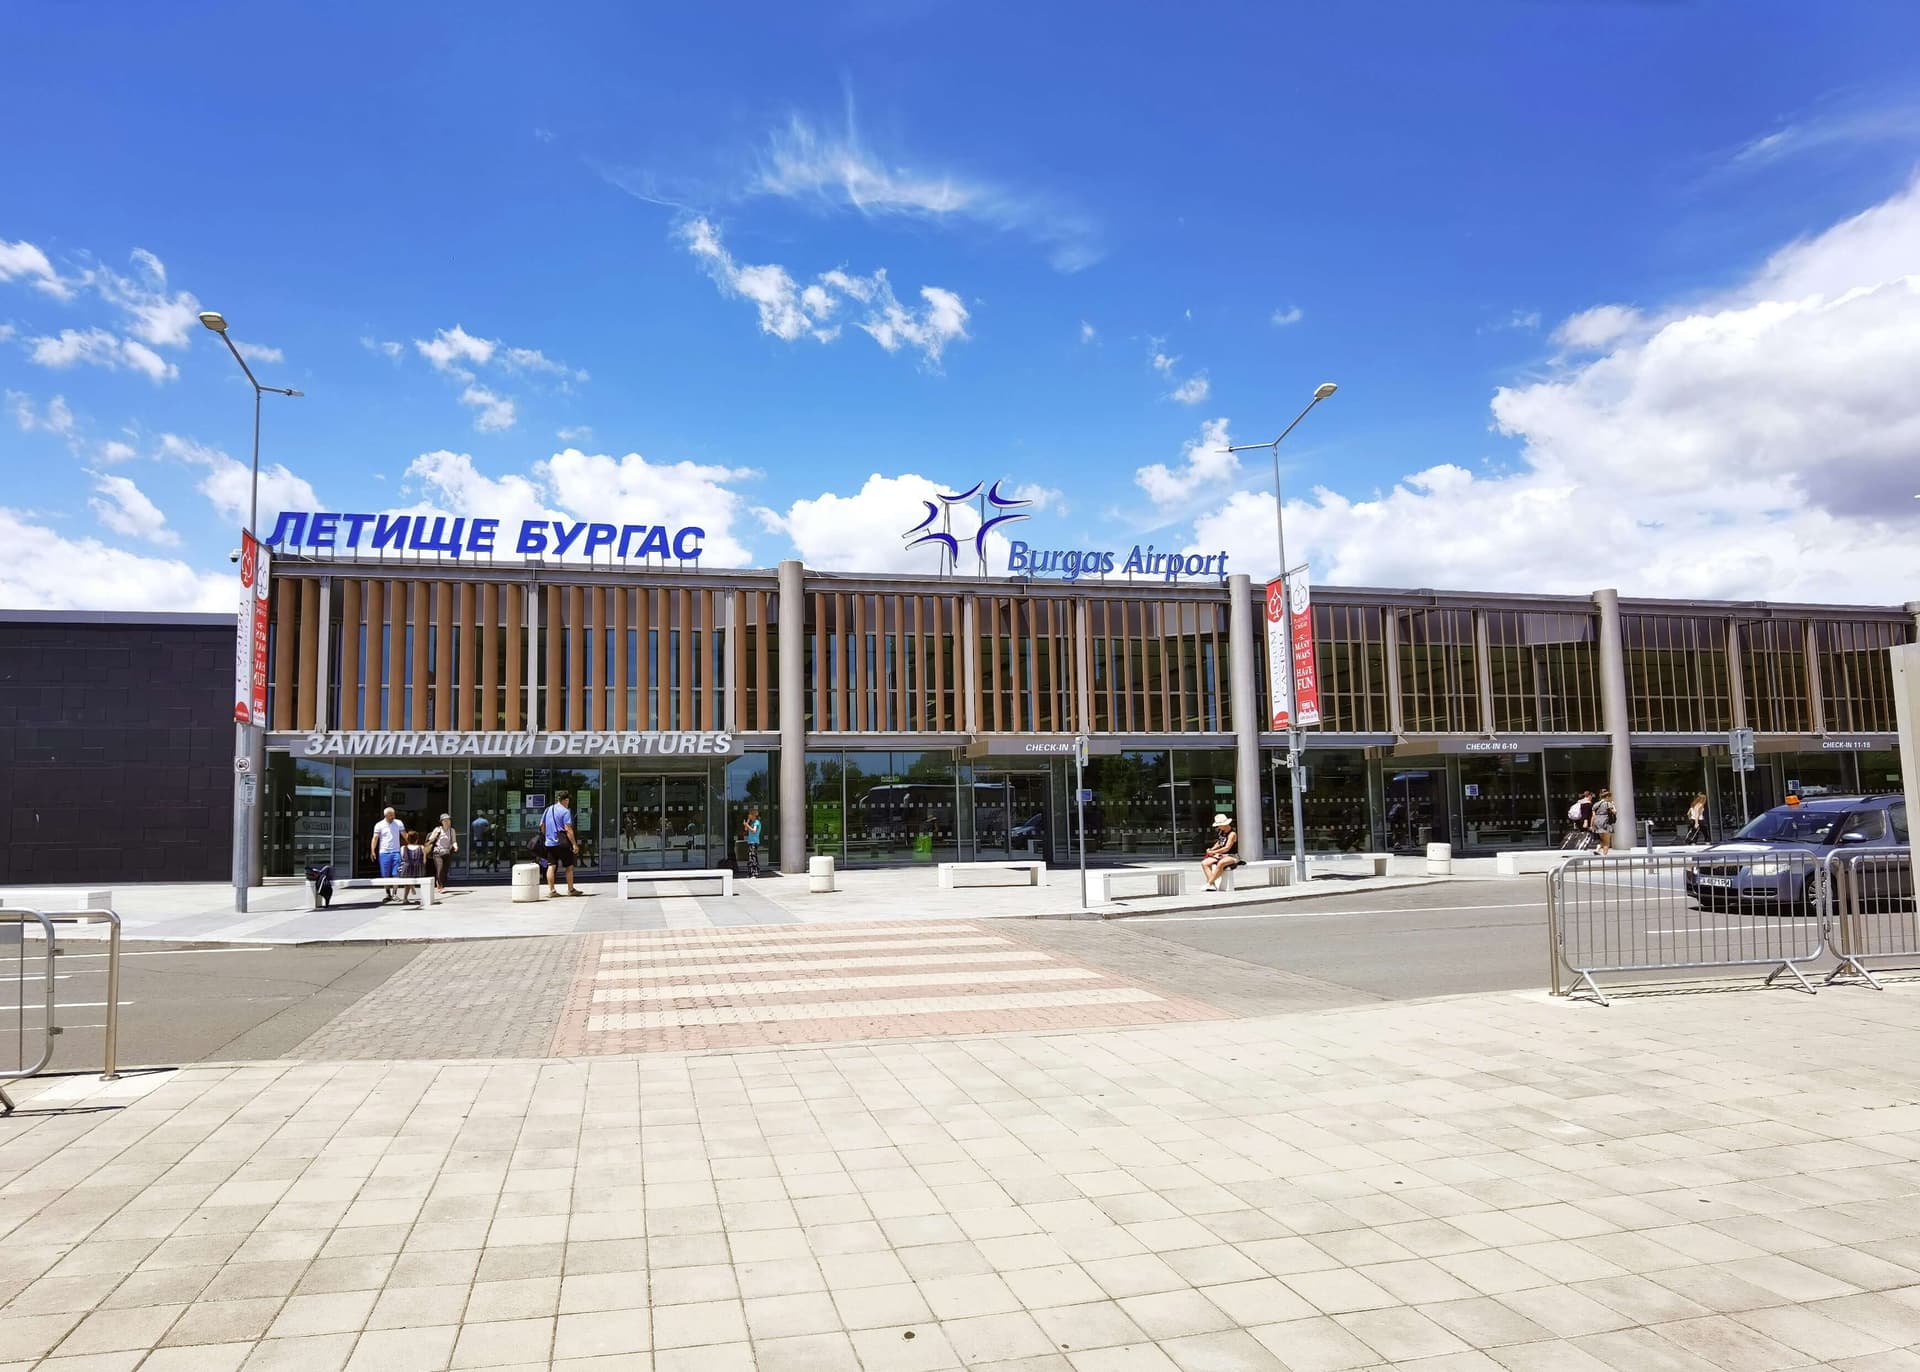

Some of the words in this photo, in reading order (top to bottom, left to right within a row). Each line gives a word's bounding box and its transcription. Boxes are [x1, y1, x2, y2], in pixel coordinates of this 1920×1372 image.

[266, 511, 500, 558] ЛЕТИЩЕ
[516, 519, 706, 560] БУРГАС
[1007, 540, 1115, 583] Burgas
[1122, 544, 1229, 583] Airport
[1297, 676, 1314, 690] FUN
[303, 733, 541, 757] ЗАМИНАВАЩИ
[544, 733, 732, 755] DEPARTURES
[1025, 743, 1069, 752] CHECK-IN
[1823, 741, 1852, 749] CHECK-IN
